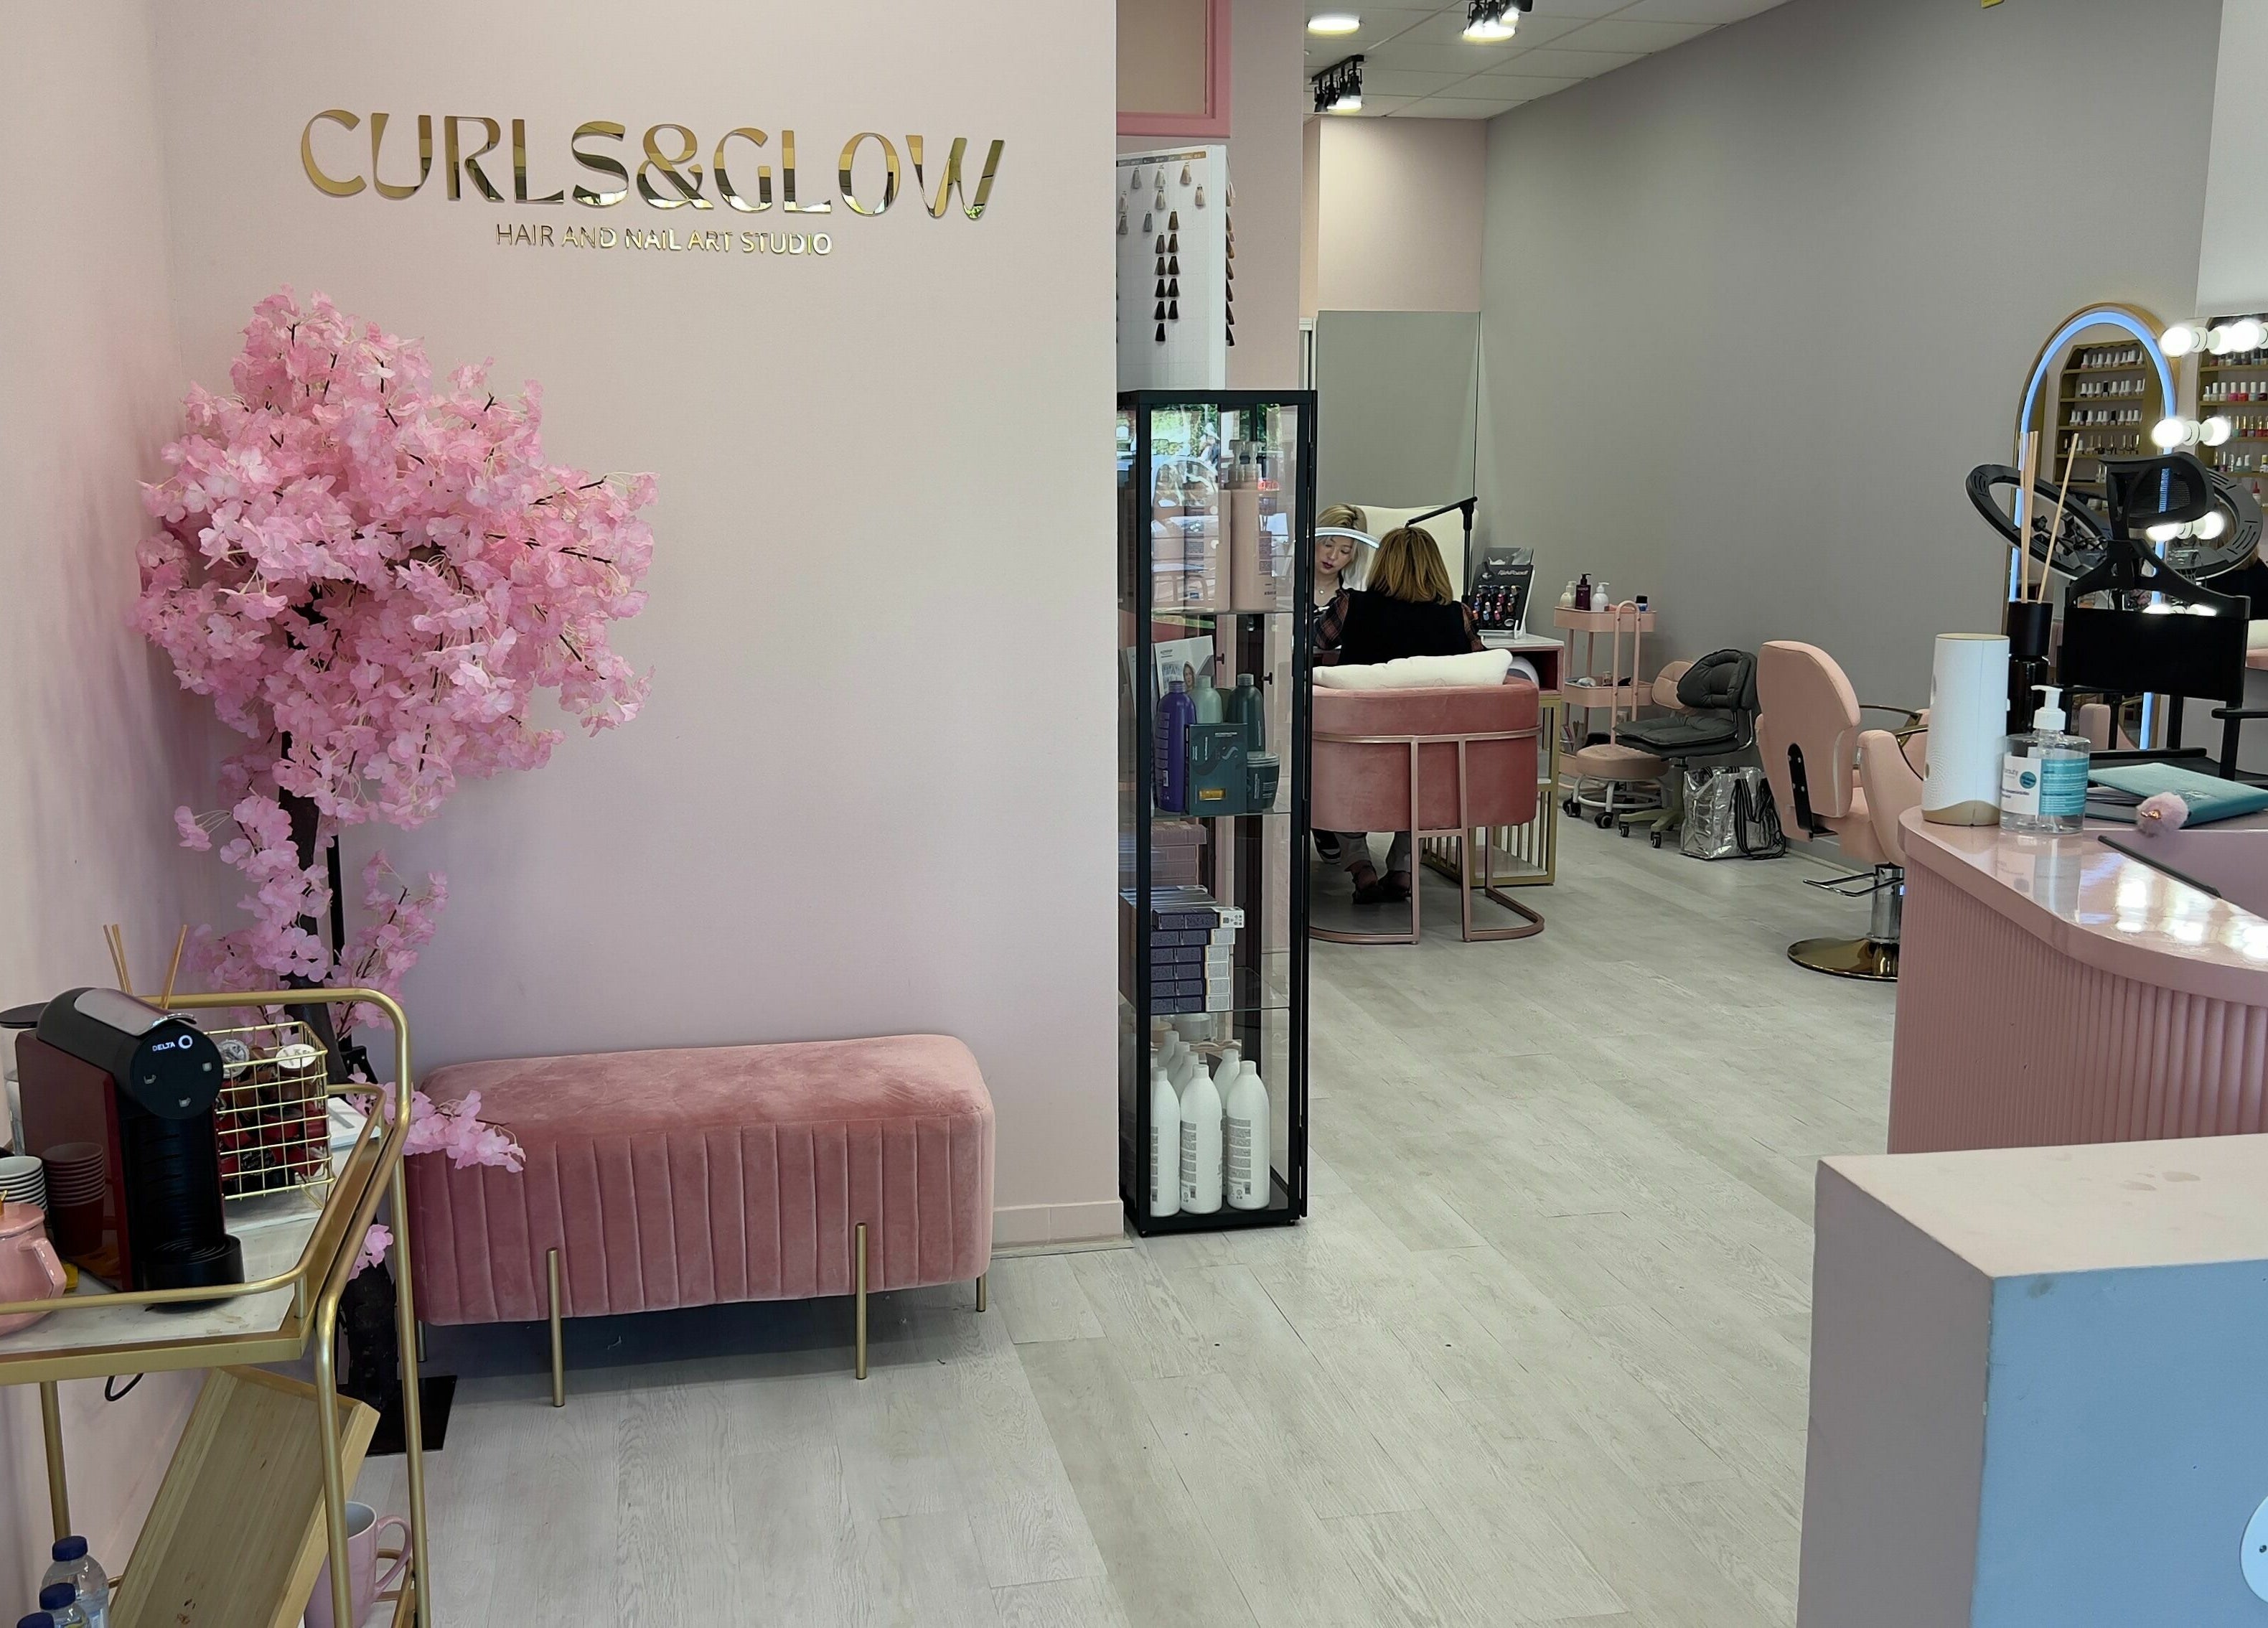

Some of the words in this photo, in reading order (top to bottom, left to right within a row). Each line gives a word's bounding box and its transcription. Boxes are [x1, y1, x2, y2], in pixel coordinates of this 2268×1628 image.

[301, 109, 1004, 220] CURLS&GLOW
[497, 223, 555, 246] HAIR
[562, 225, 617, 248] AND
[624, 228, 682, 251] NAIL
[688, 230, 733, 252] ART
[740, 232, 833, 255] STUDIO
[152, 1041, 176, 1052] DELTA
